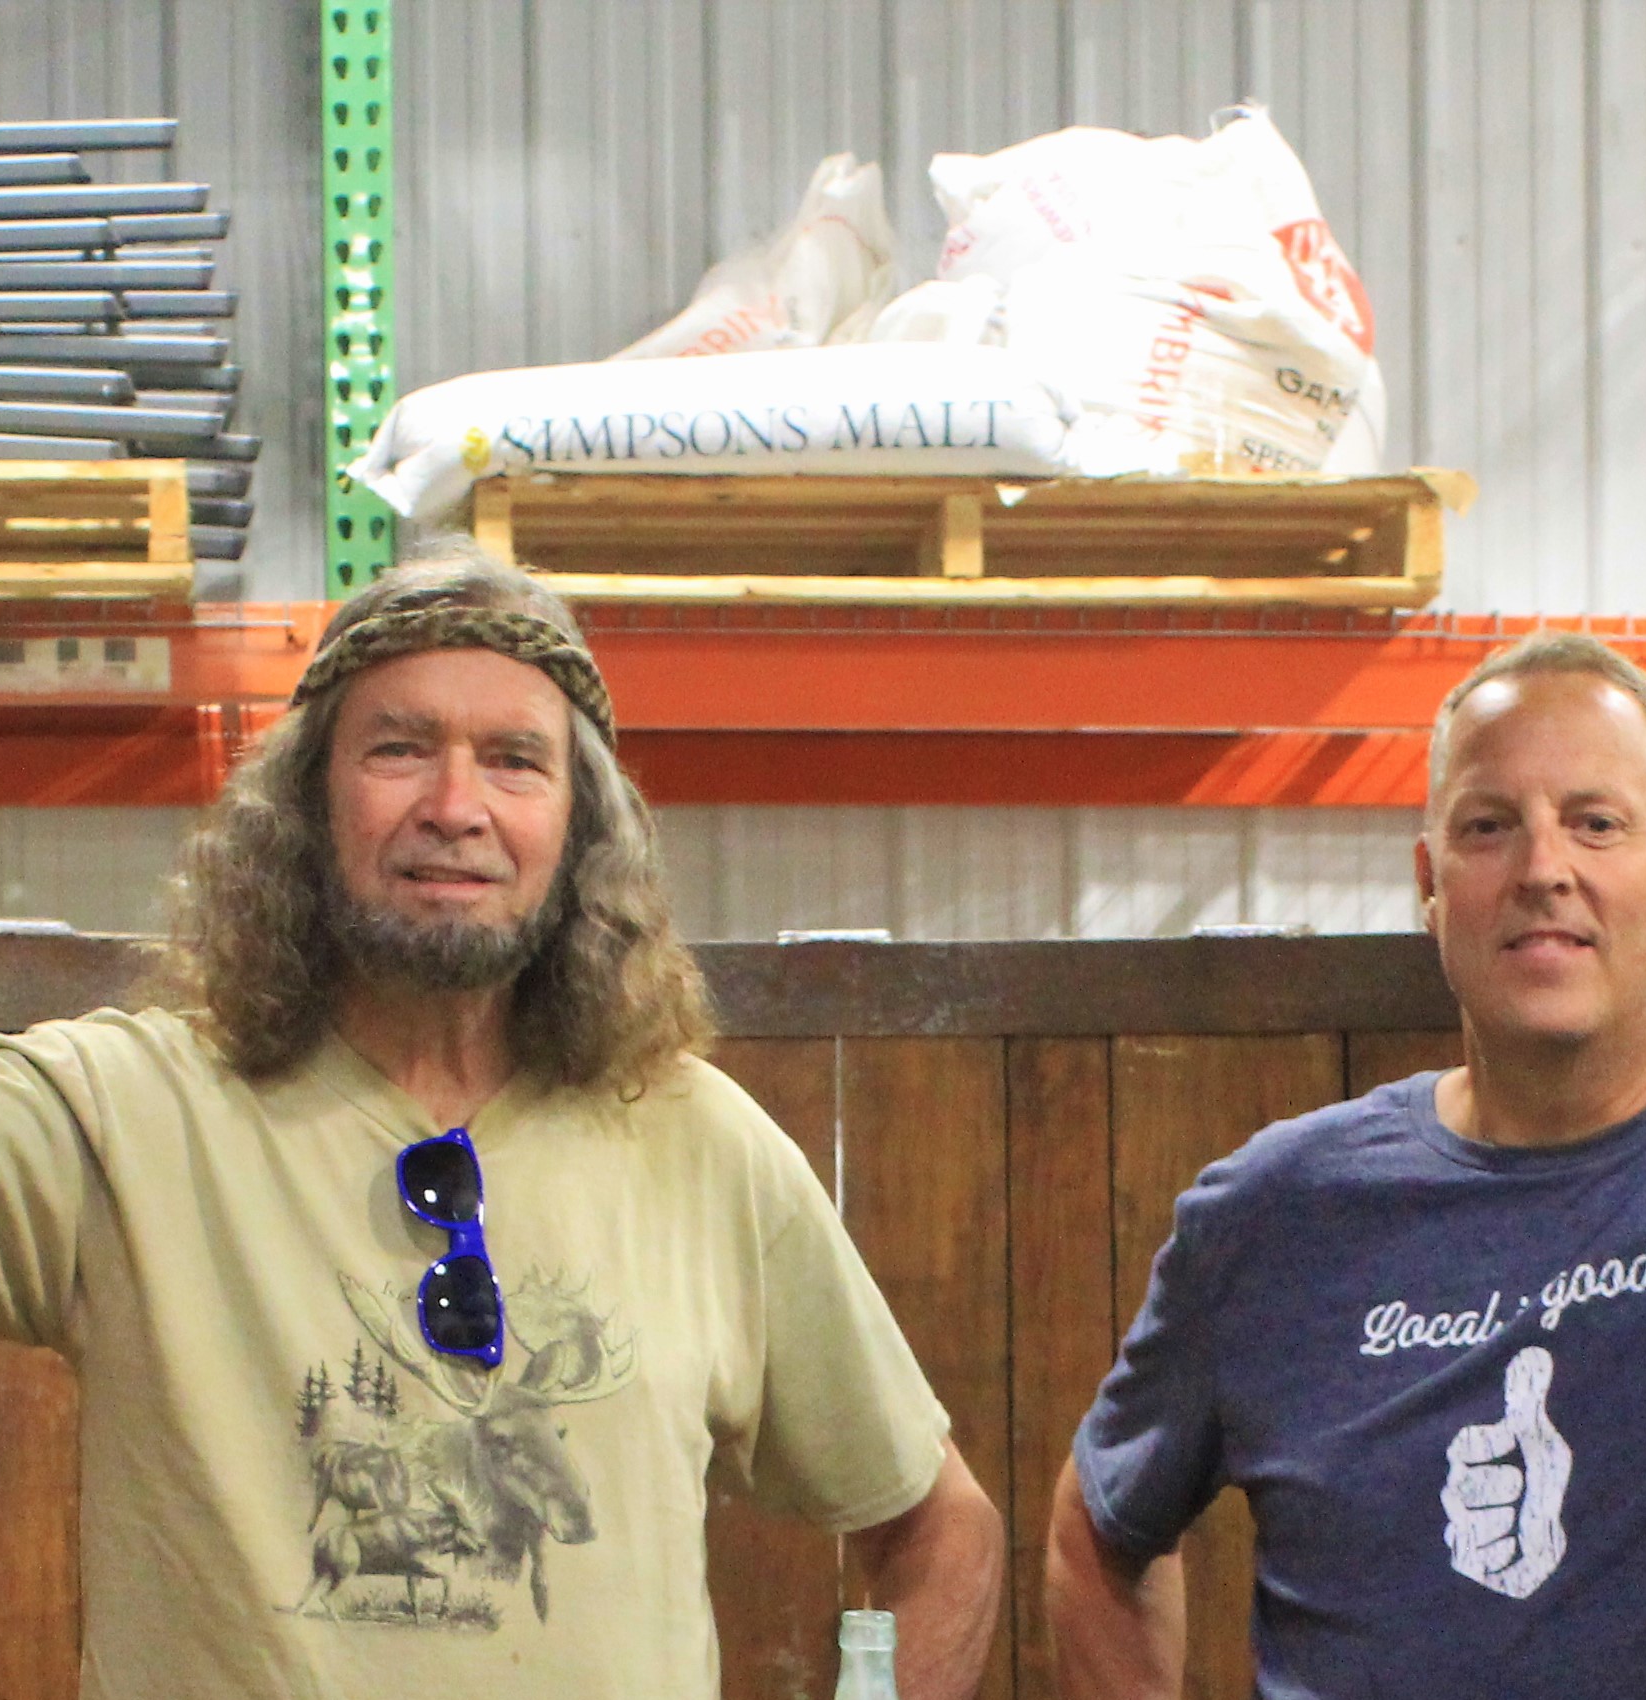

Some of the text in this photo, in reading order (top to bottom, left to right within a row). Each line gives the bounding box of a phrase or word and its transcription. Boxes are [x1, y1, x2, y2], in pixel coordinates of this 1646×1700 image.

[501, 399, 1012, 463] SIMPSONS MALT
[1359, 1290, 1504, 1356] Local
